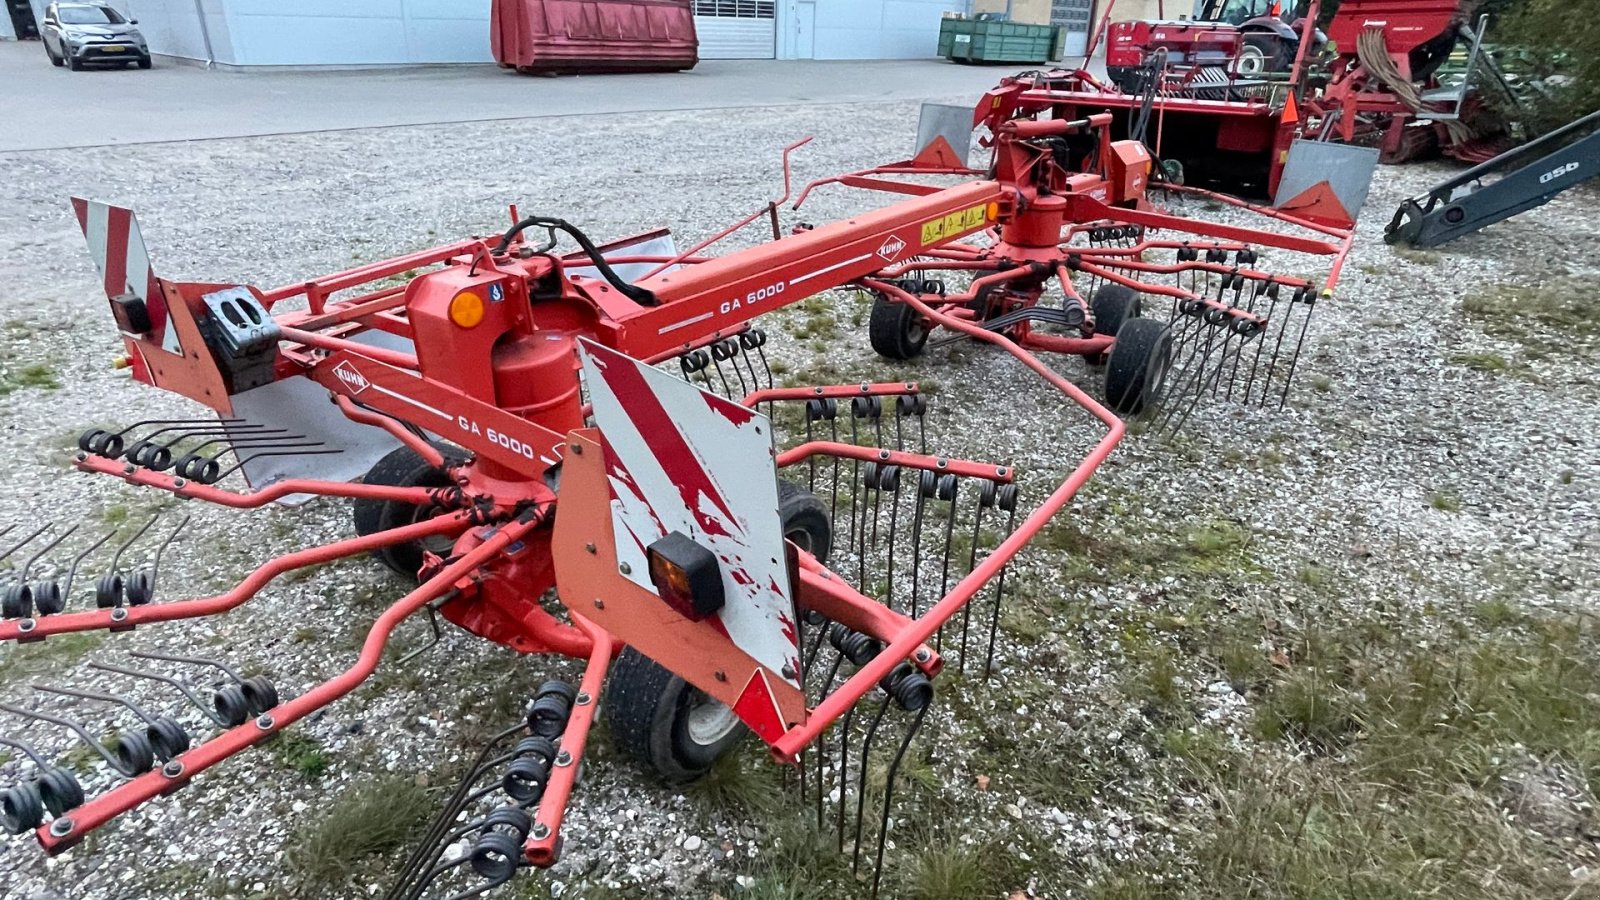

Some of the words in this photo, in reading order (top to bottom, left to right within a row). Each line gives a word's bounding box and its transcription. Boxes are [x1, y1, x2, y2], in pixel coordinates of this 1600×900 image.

[880, 241, 902, 257] KUHN
[720, 298, 742, 315] GA
[747, 282, 785, 304] 6000
[336, 368, 365, 387] KUHN
[458, 416, 481, 436] GA
[487, 428, 534, 459] 6000
